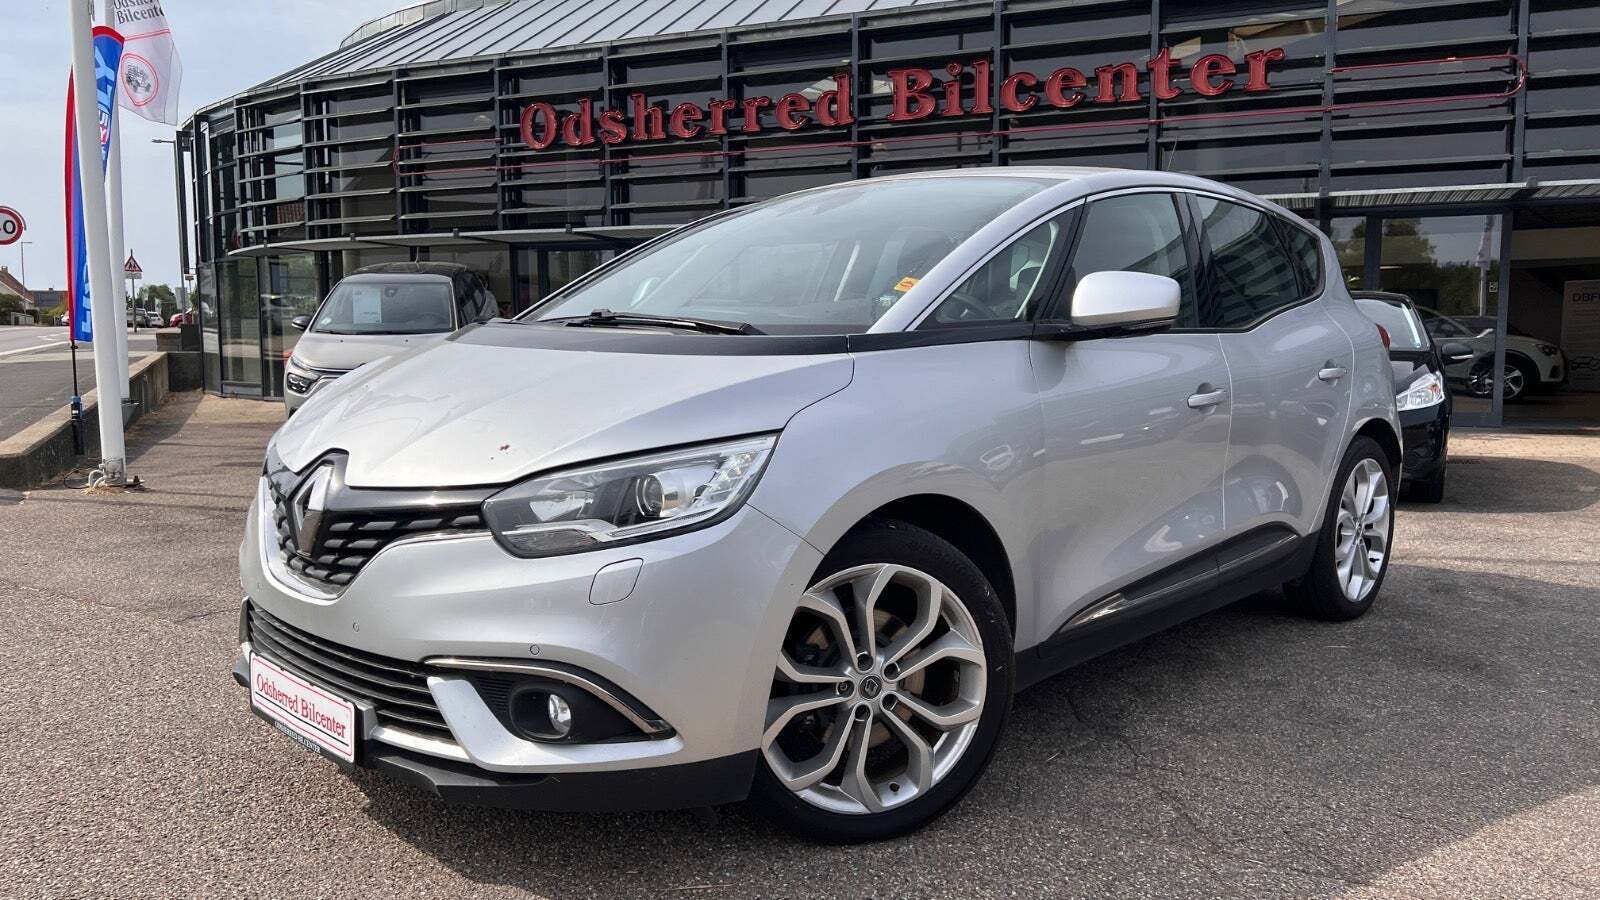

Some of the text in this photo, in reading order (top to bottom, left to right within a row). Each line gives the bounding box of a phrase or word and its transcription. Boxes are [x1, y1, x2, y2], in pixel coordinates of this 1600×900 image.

[519, 42, 1285, 150] Odsherred Bilcenter
[256, 673, 346, 738] Odsherred Bilcenter
